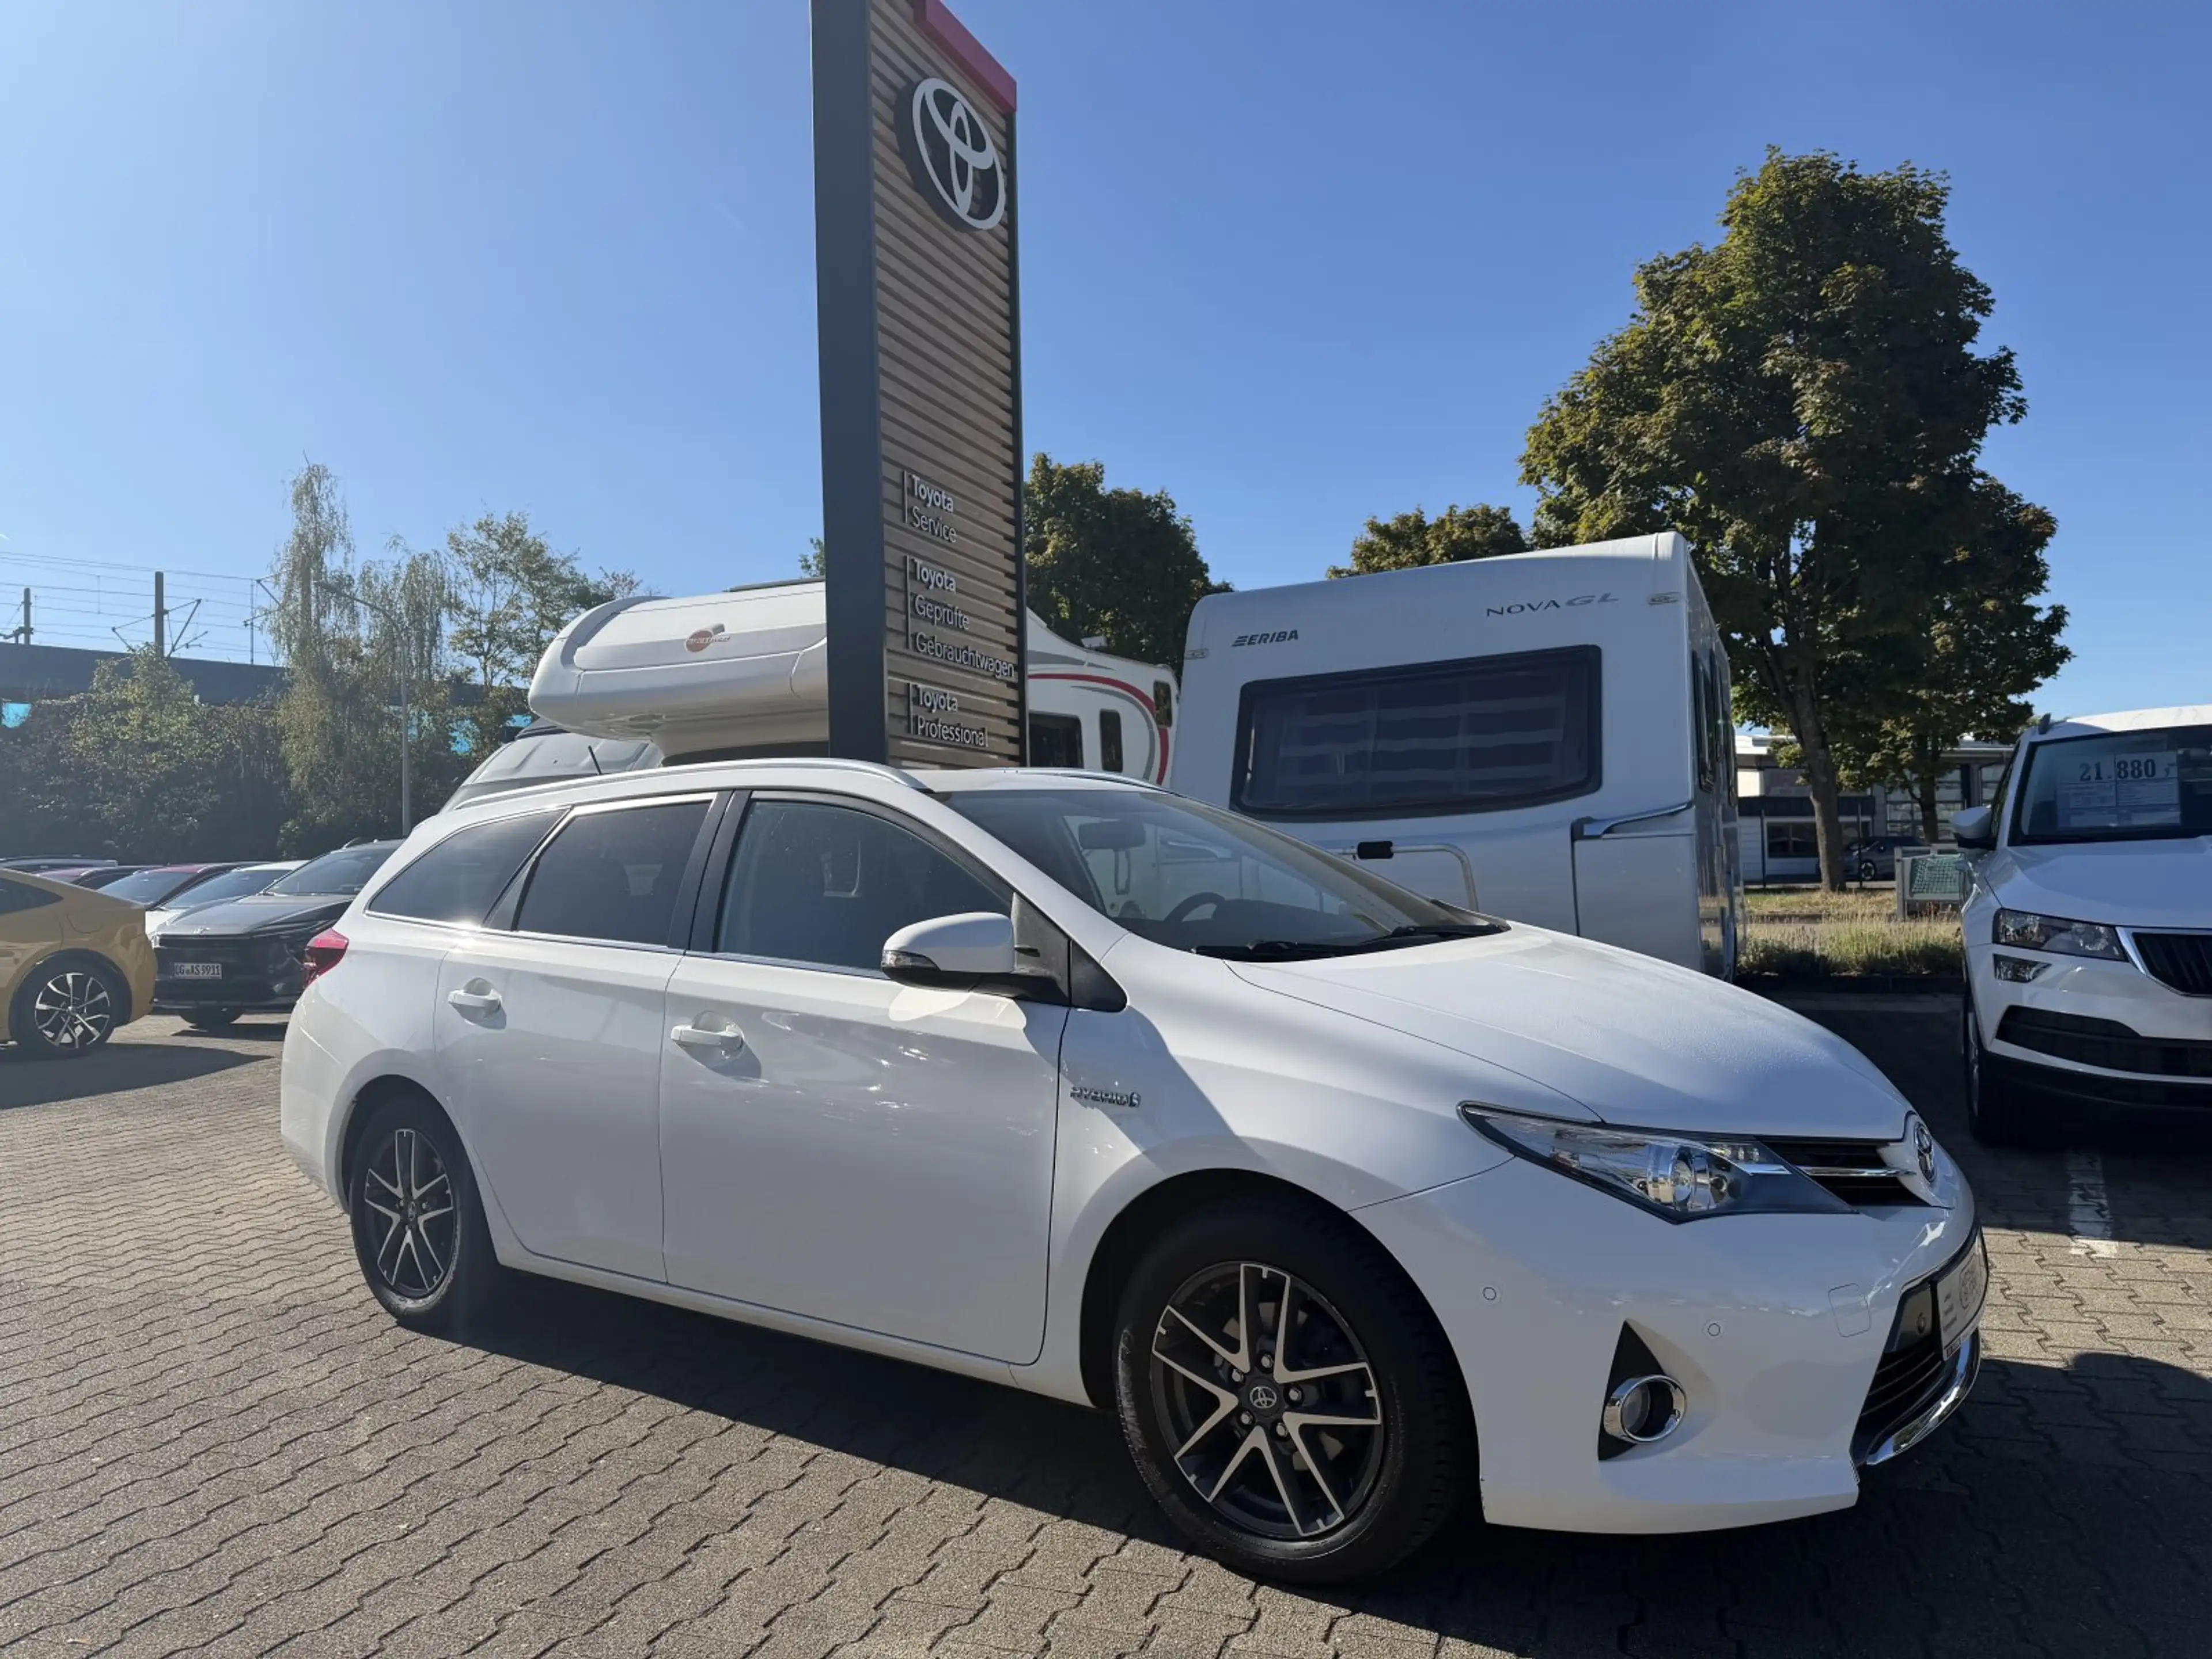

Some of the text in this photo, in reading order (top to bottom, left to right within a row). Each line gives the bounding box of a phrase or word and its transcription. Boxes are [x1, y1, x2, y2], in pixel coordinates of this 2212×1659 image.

[911, 474, 954, 512] Toyota
[912, 506, 957, 543] Service
[914, 558, 956, 593] Toyota
[916, 631, 1014, 679] Gebrauchtwagen
[1247, 629, 1299, 646] ERIBA
[916, 684, 958, 713] Toyota
[918, 715, 988, 748] Professional
